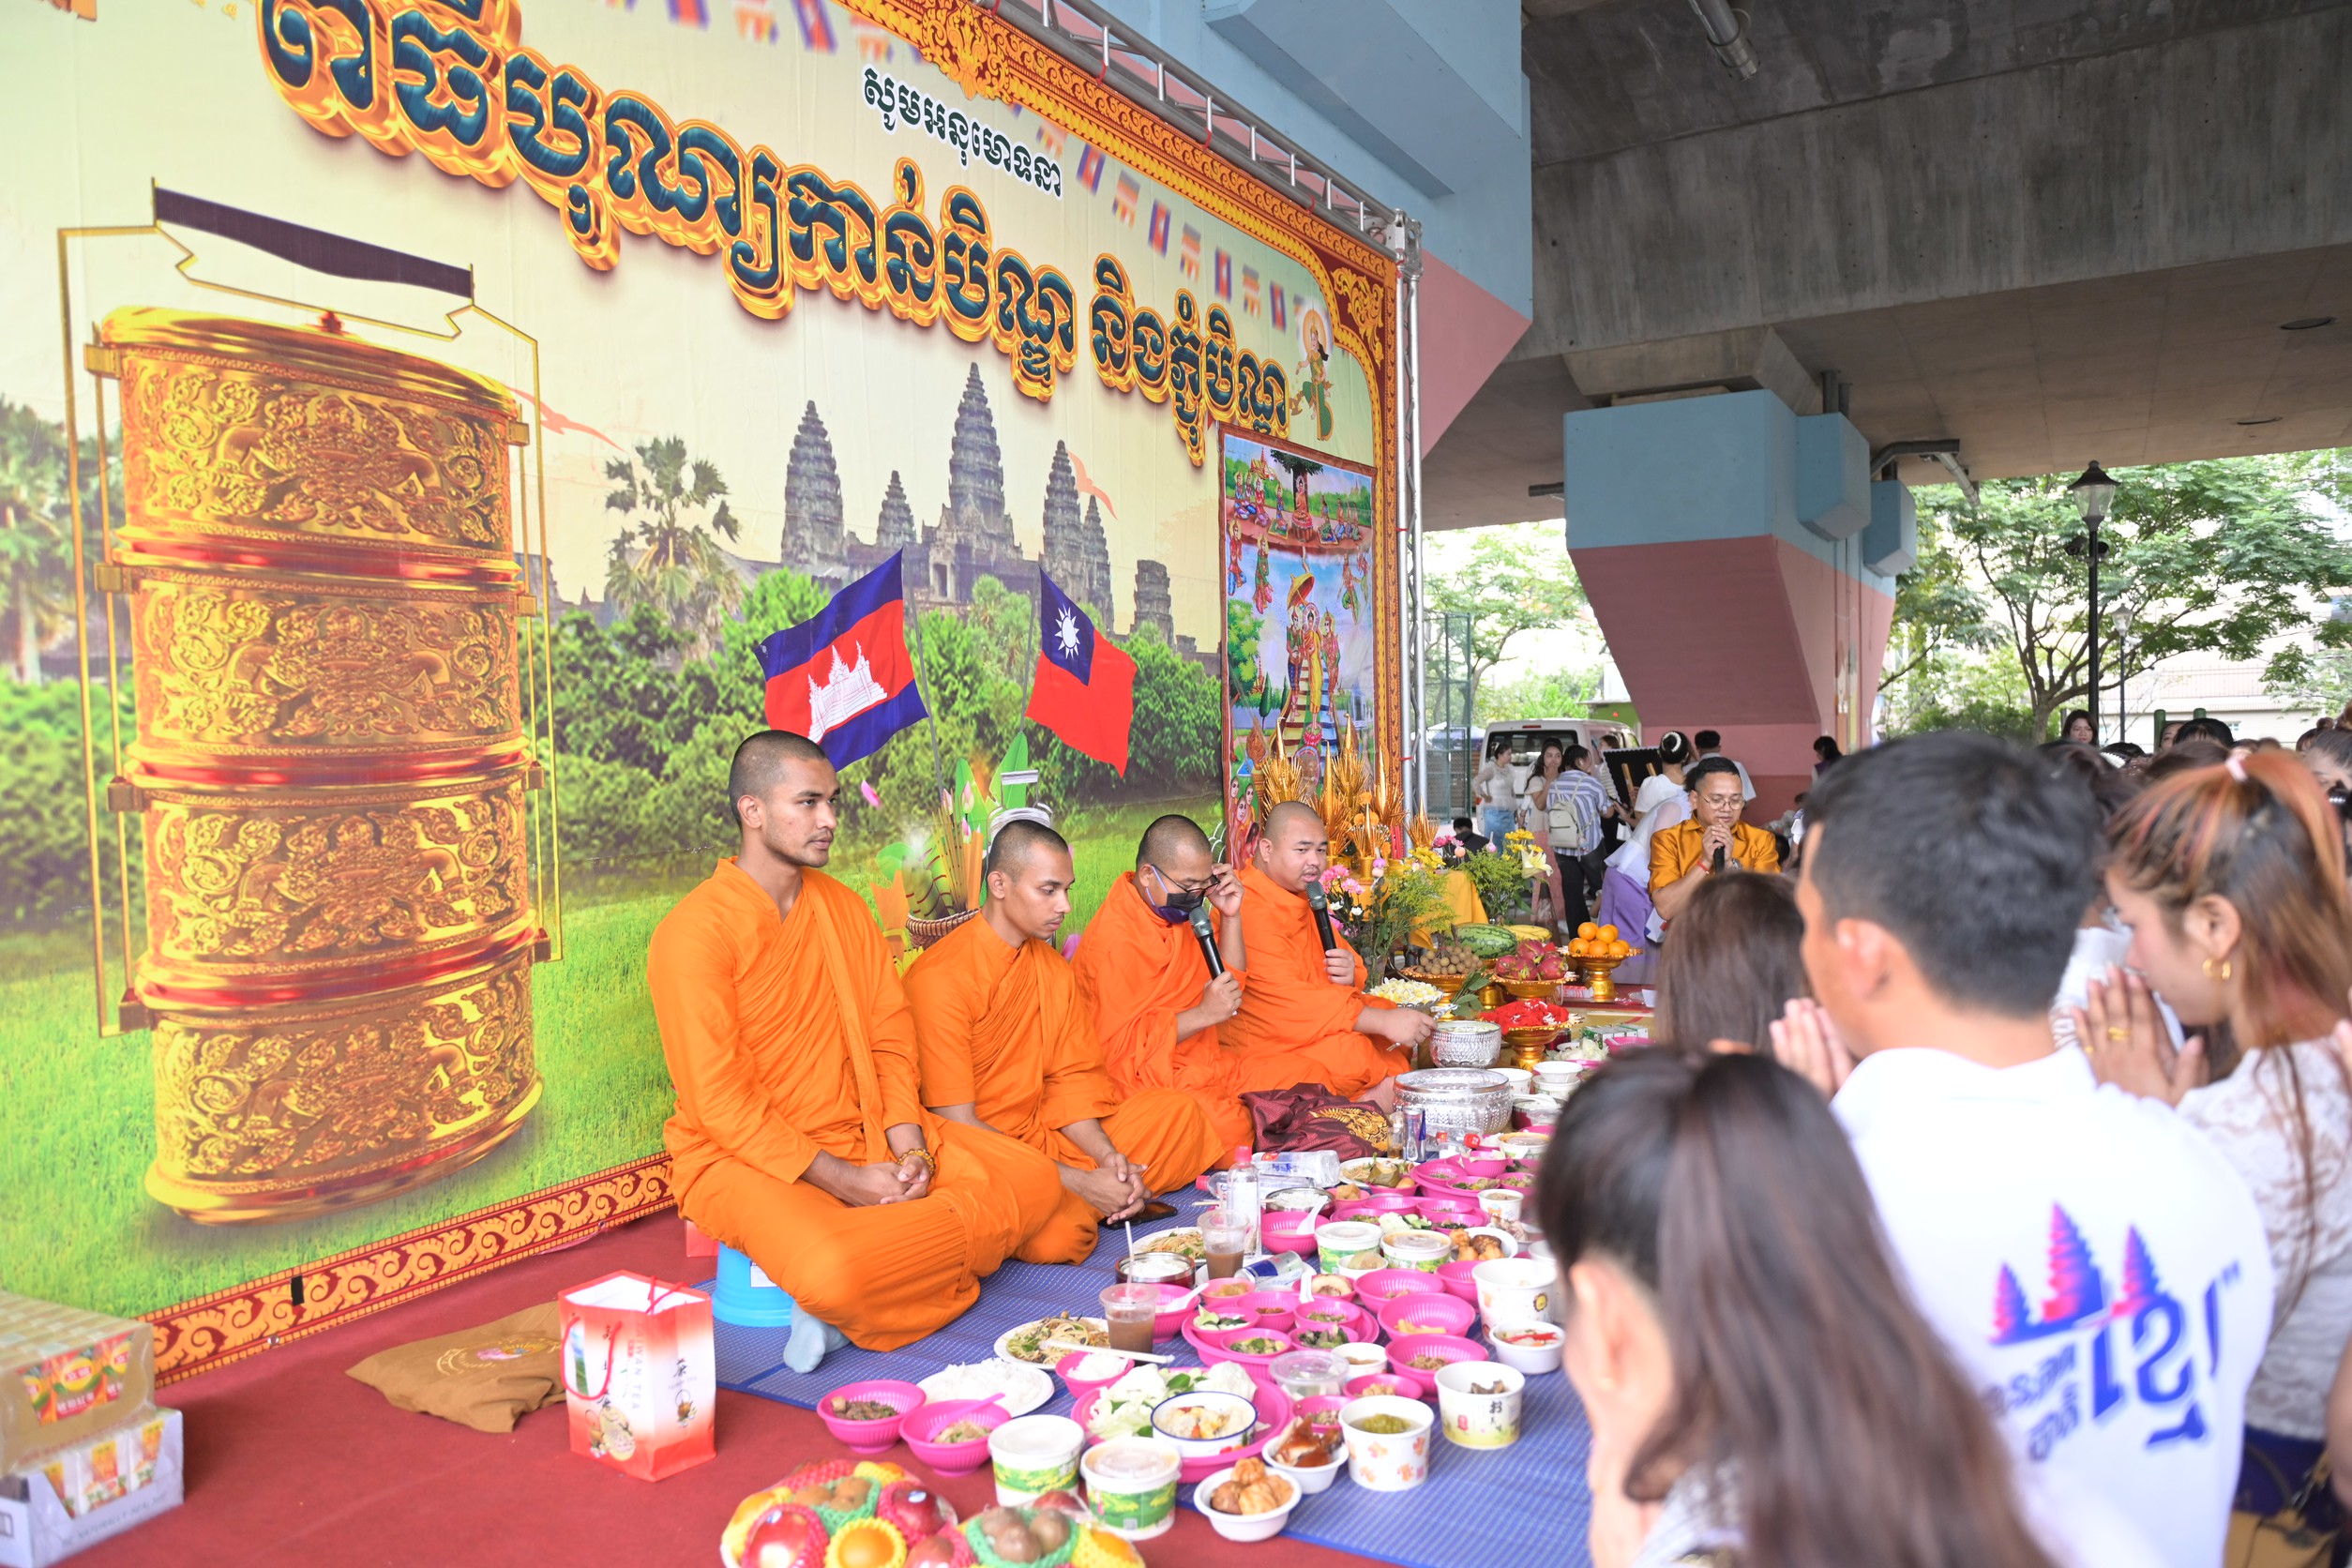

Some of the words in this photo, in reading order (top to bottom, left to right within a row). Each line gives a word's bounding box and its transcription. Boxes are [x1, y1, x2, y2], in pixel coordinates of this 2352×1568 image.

[864, 66, 1062, 198] សូមអនុមោទនា
[635, 1321, 644, 1376] TAIWAN
[631, 1383, 641, 1410] TEA
